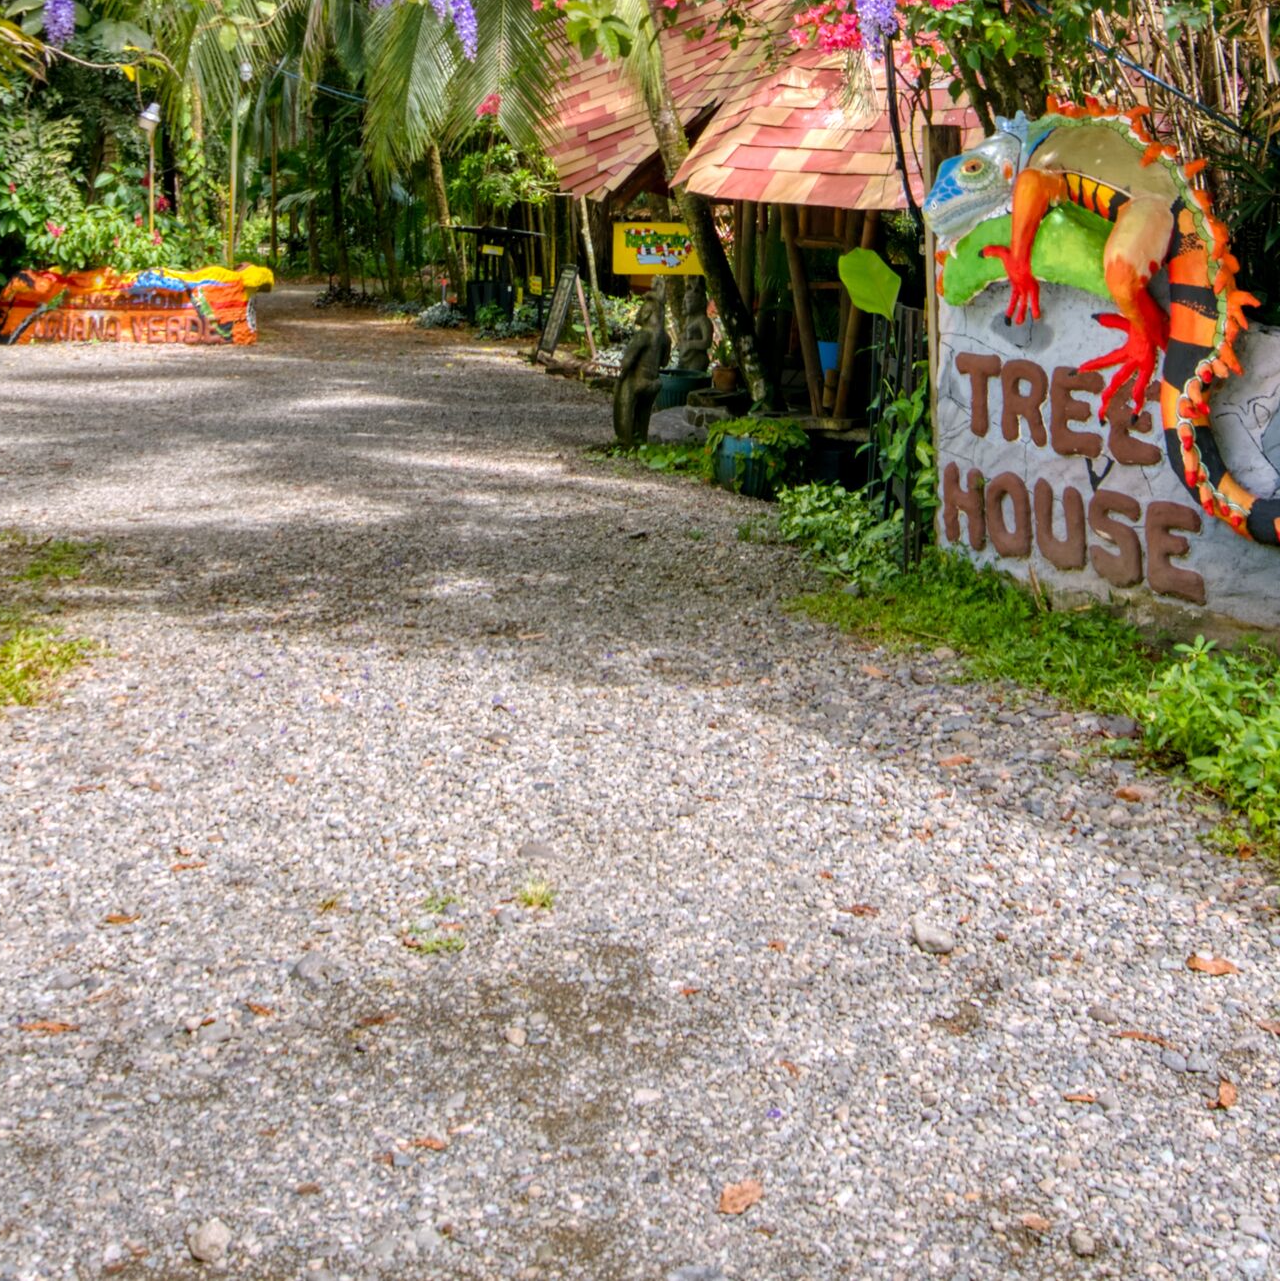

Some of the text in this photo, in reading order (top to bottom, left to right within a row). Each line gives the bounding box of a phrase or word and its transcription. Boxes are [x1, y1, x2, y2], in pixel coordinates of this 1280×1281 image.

[130, 316, 227, 345] VERDE
[955, 352, 1164, 466] TREE
[943, 461, 1207, 606] HOUSE
